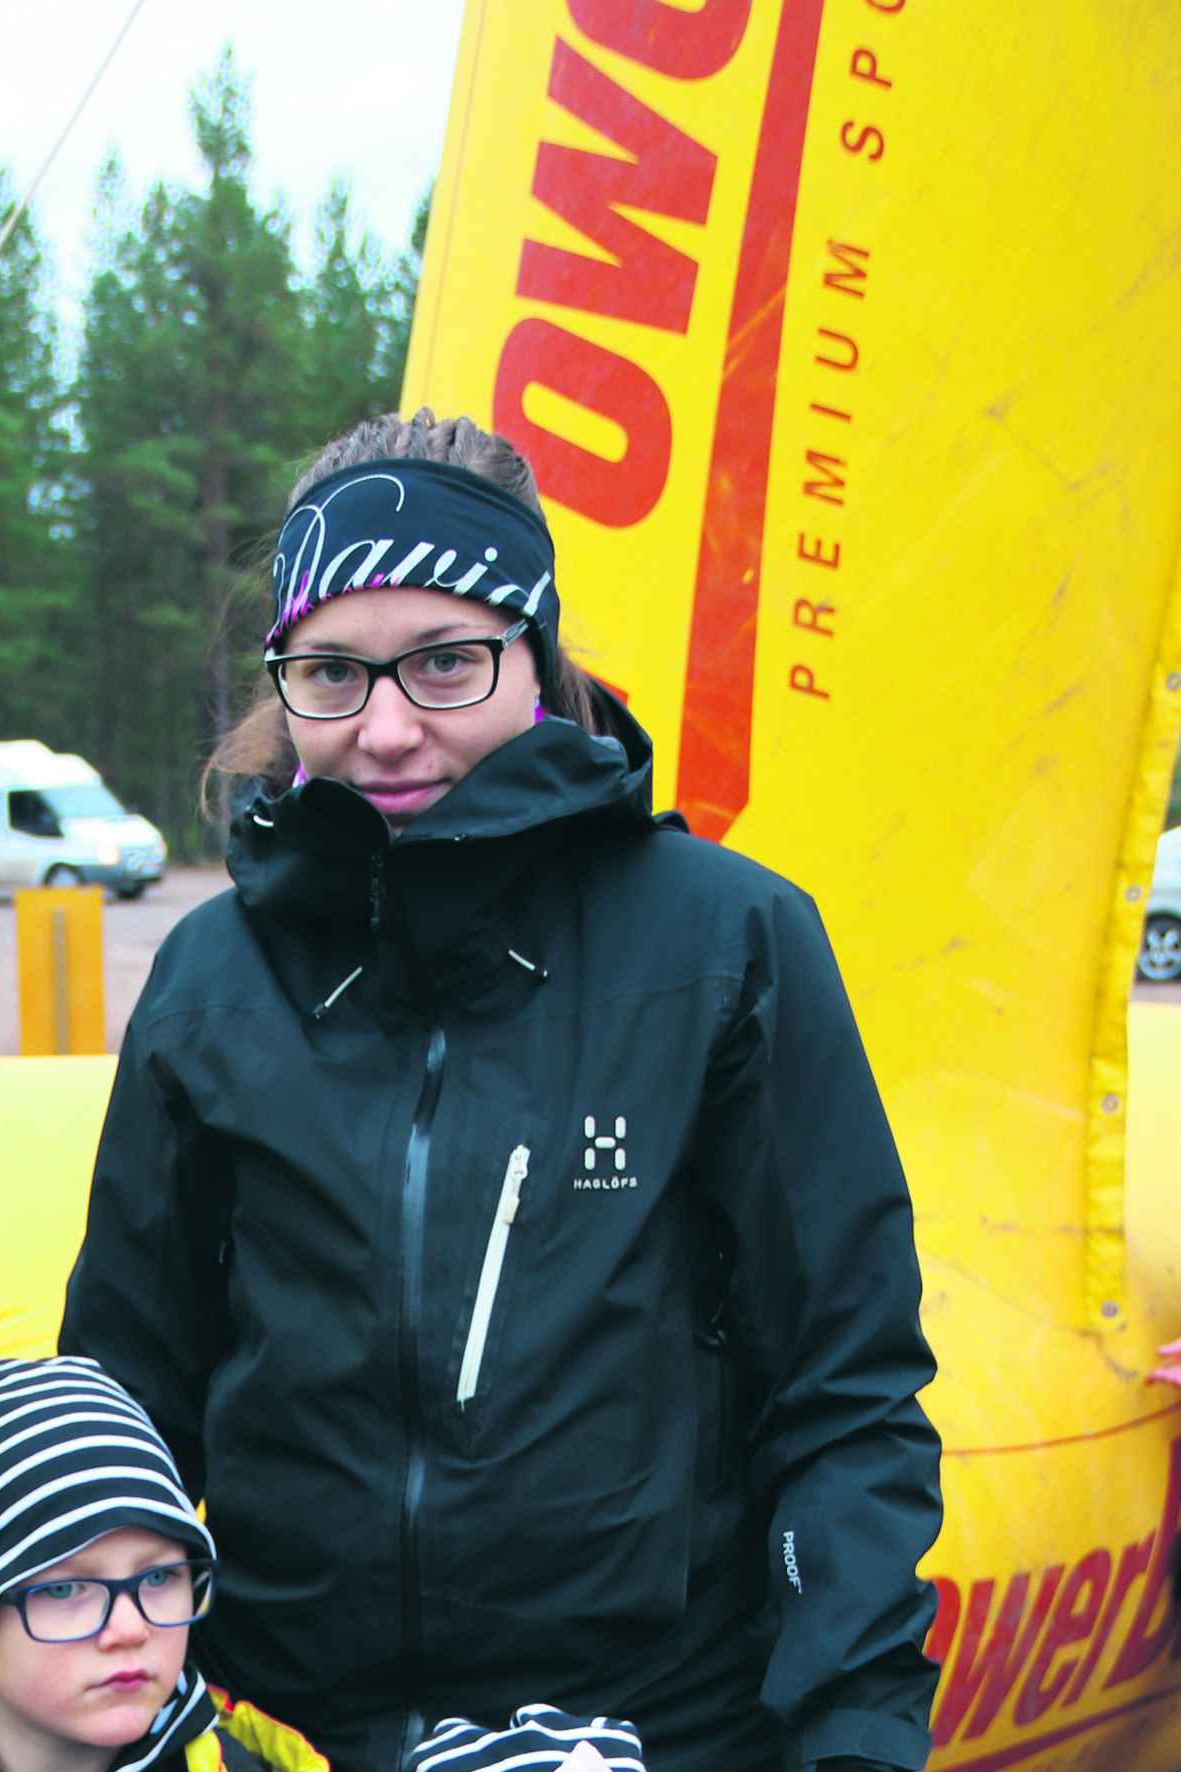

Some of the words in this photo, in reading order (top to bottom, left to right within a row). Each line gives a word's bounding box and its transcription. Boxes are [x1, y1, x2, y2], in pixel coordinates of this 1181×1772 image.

[789, 239, 871, 701] PREMIUM
[573, 1176, 638, 1190] HAGLÖFS
[783, 1530, 802, 1588] PROOF
